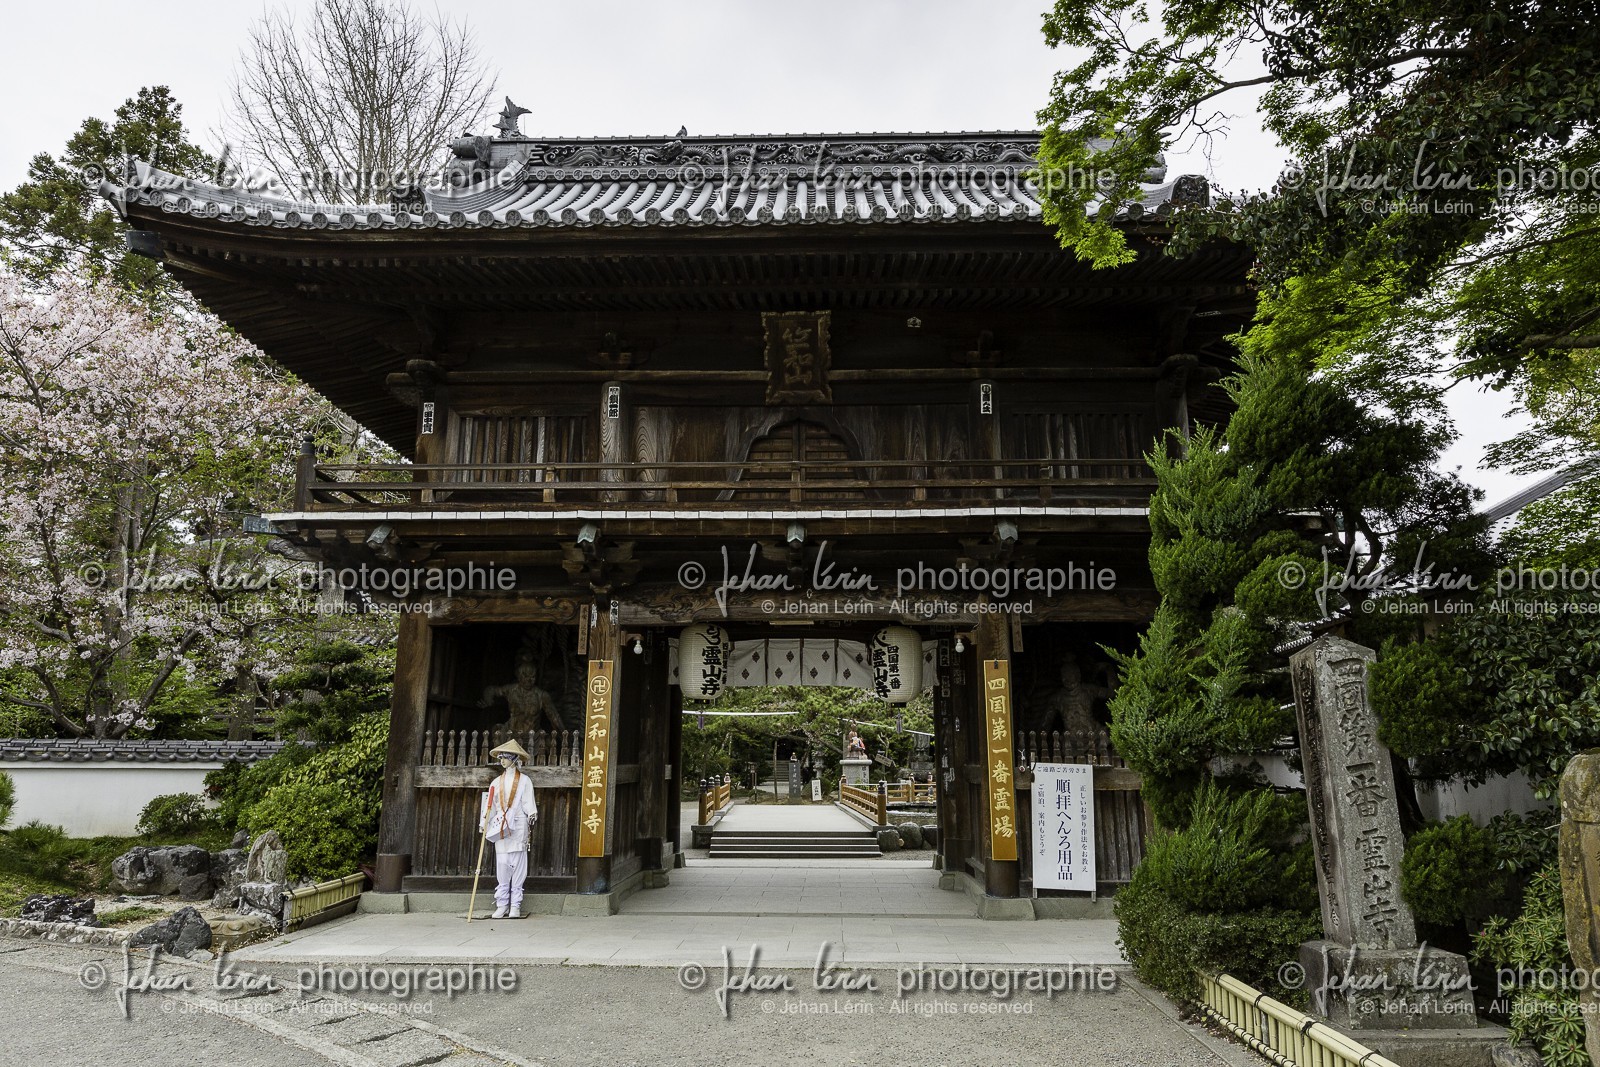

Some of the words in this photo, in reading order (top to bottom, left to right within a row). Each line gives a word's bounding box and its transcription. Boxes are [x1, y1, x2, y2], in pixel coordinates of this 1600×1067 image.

[987, 677, 1014, 838] 四国第一番霊場
[1055, 779, 1073, 880] 順拝へんろ用品
